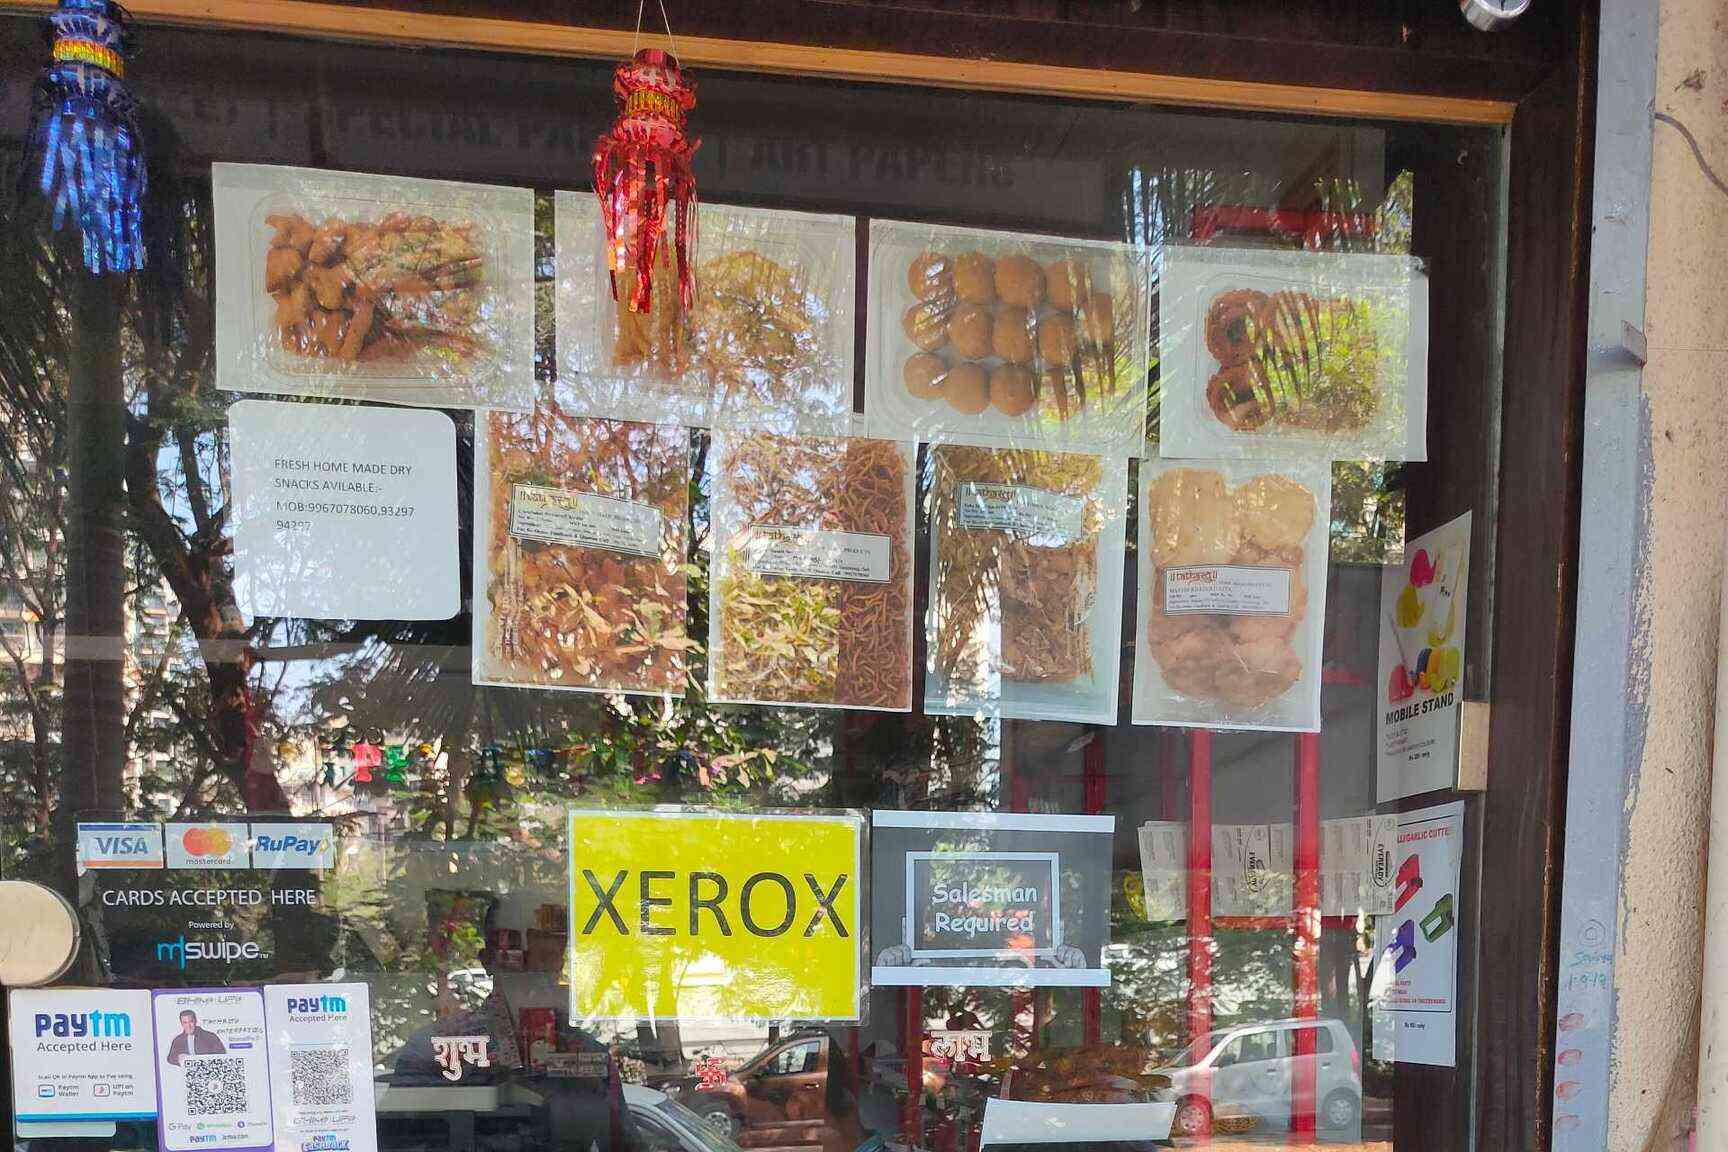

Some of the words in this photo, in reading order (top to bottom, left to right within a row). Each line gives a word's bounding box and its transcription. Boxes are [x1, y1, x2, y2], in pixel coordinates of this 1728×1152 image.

[275, 459, 309, 471] FRESH
[314, 462, 348, 472] HOME
[352, 463, 386, 474] MADE
[390, 464, 412, 476] DRY
[275, 478, 319, 490] SNACKS
[1385, 705, 1420, 725] MOBILE
[1422, 692, 1454, 714] STAND
[94, 837, 149, 855] VISA
[256, 835, 320, 856] RuPay
[186, 857, 231, 865] mastercard
[103, 890, 164, 906] CARDS
[170, 890, 262, 906] ACCEPTED
[271, 889, 316, 905] HERE
[932, 882, 1038, 903] Salesman
[581, 868, 850, 938] XEROX
[188, 920, 222, 929] Powered
[224, 920, 235, 931] by
[935, 910, 1034, 938] Required
[290, 1014, 326, 1024] Accepted
[36, 1042, 96, 1054] Accepted
[101, 1042, 132, 1051] Here
[930, 1030, 992, 1062] लाभ
[430, 1036, 490, 1081] शुभ
